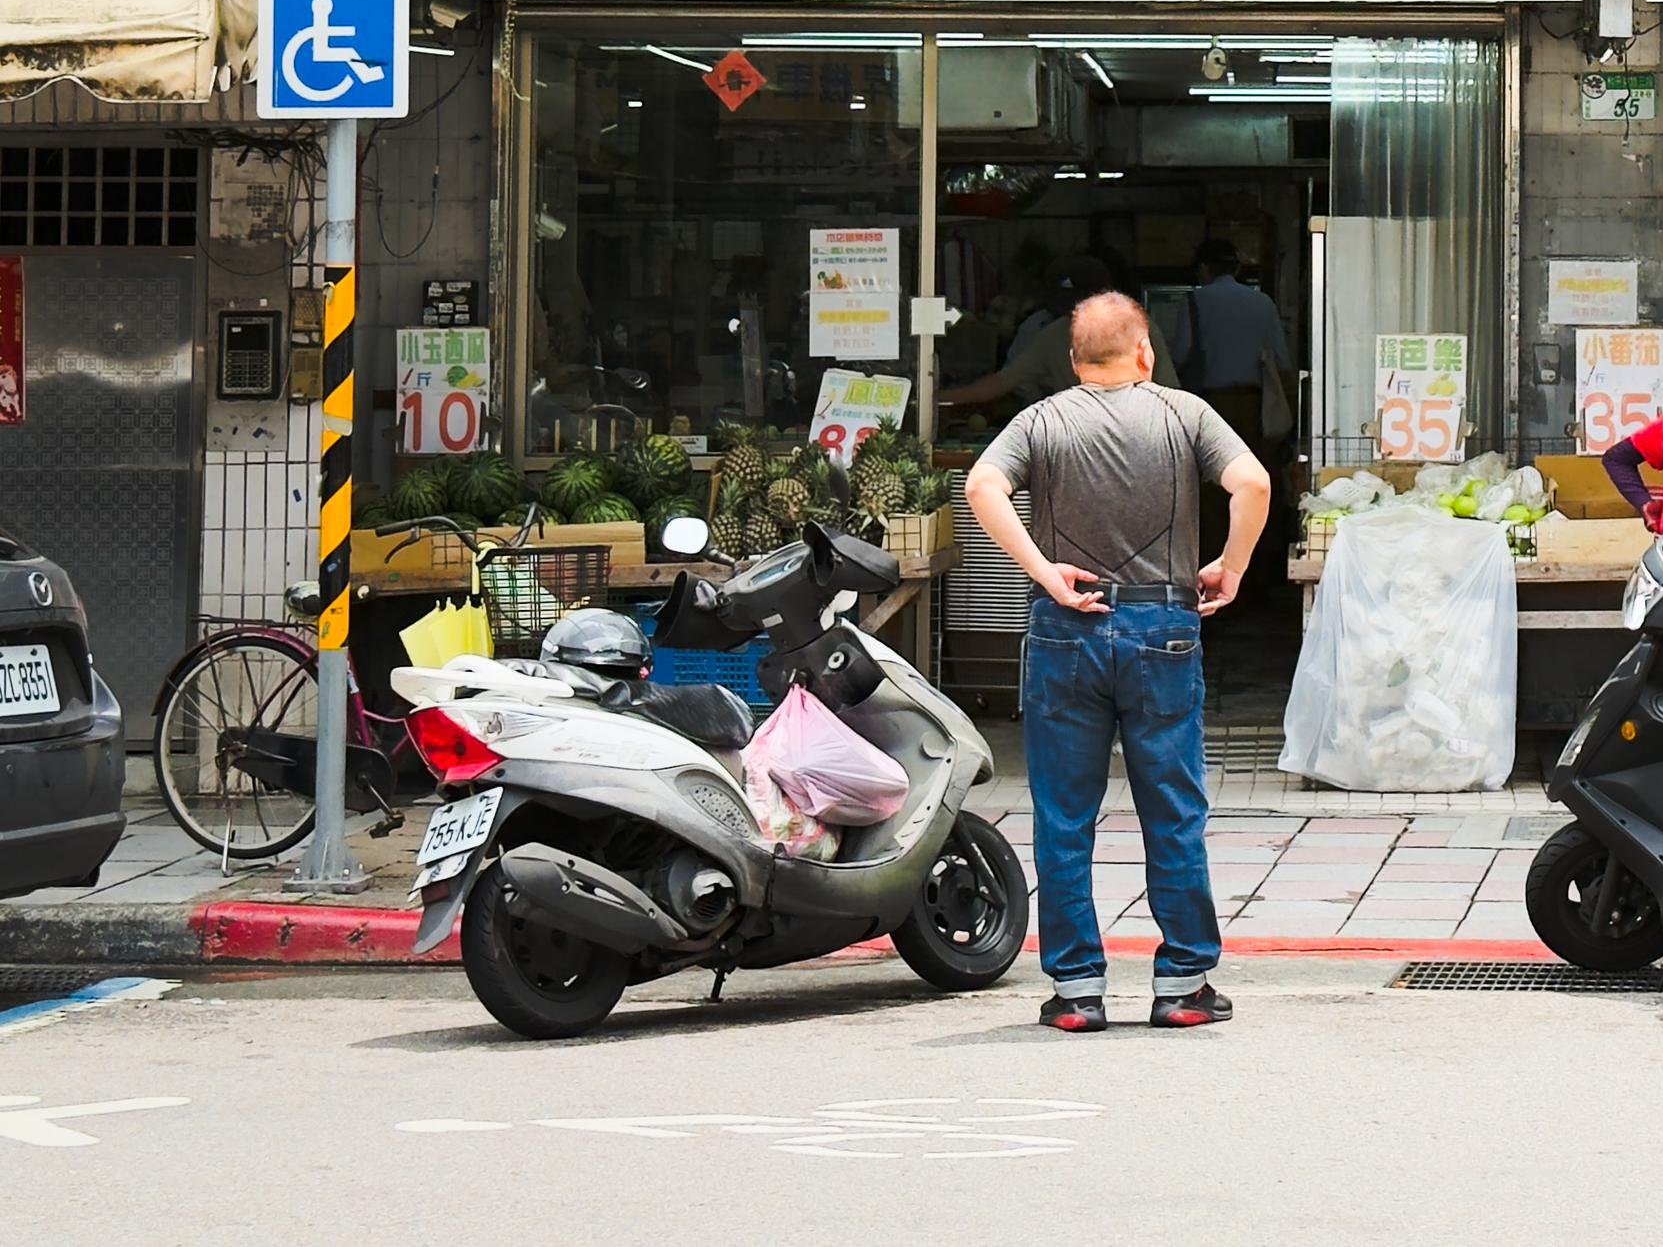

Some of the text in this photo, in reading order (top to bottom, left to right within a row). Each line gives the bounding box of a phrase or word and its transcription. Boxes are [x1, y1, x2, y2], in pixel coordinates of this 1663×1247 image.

[401, 331, 486, 365] 小玉西瓜
[1582, 333, 1661, 366] 小番茄
[402, 391, 476, 452] 10
[1381, 397, 1452, 458] 35
